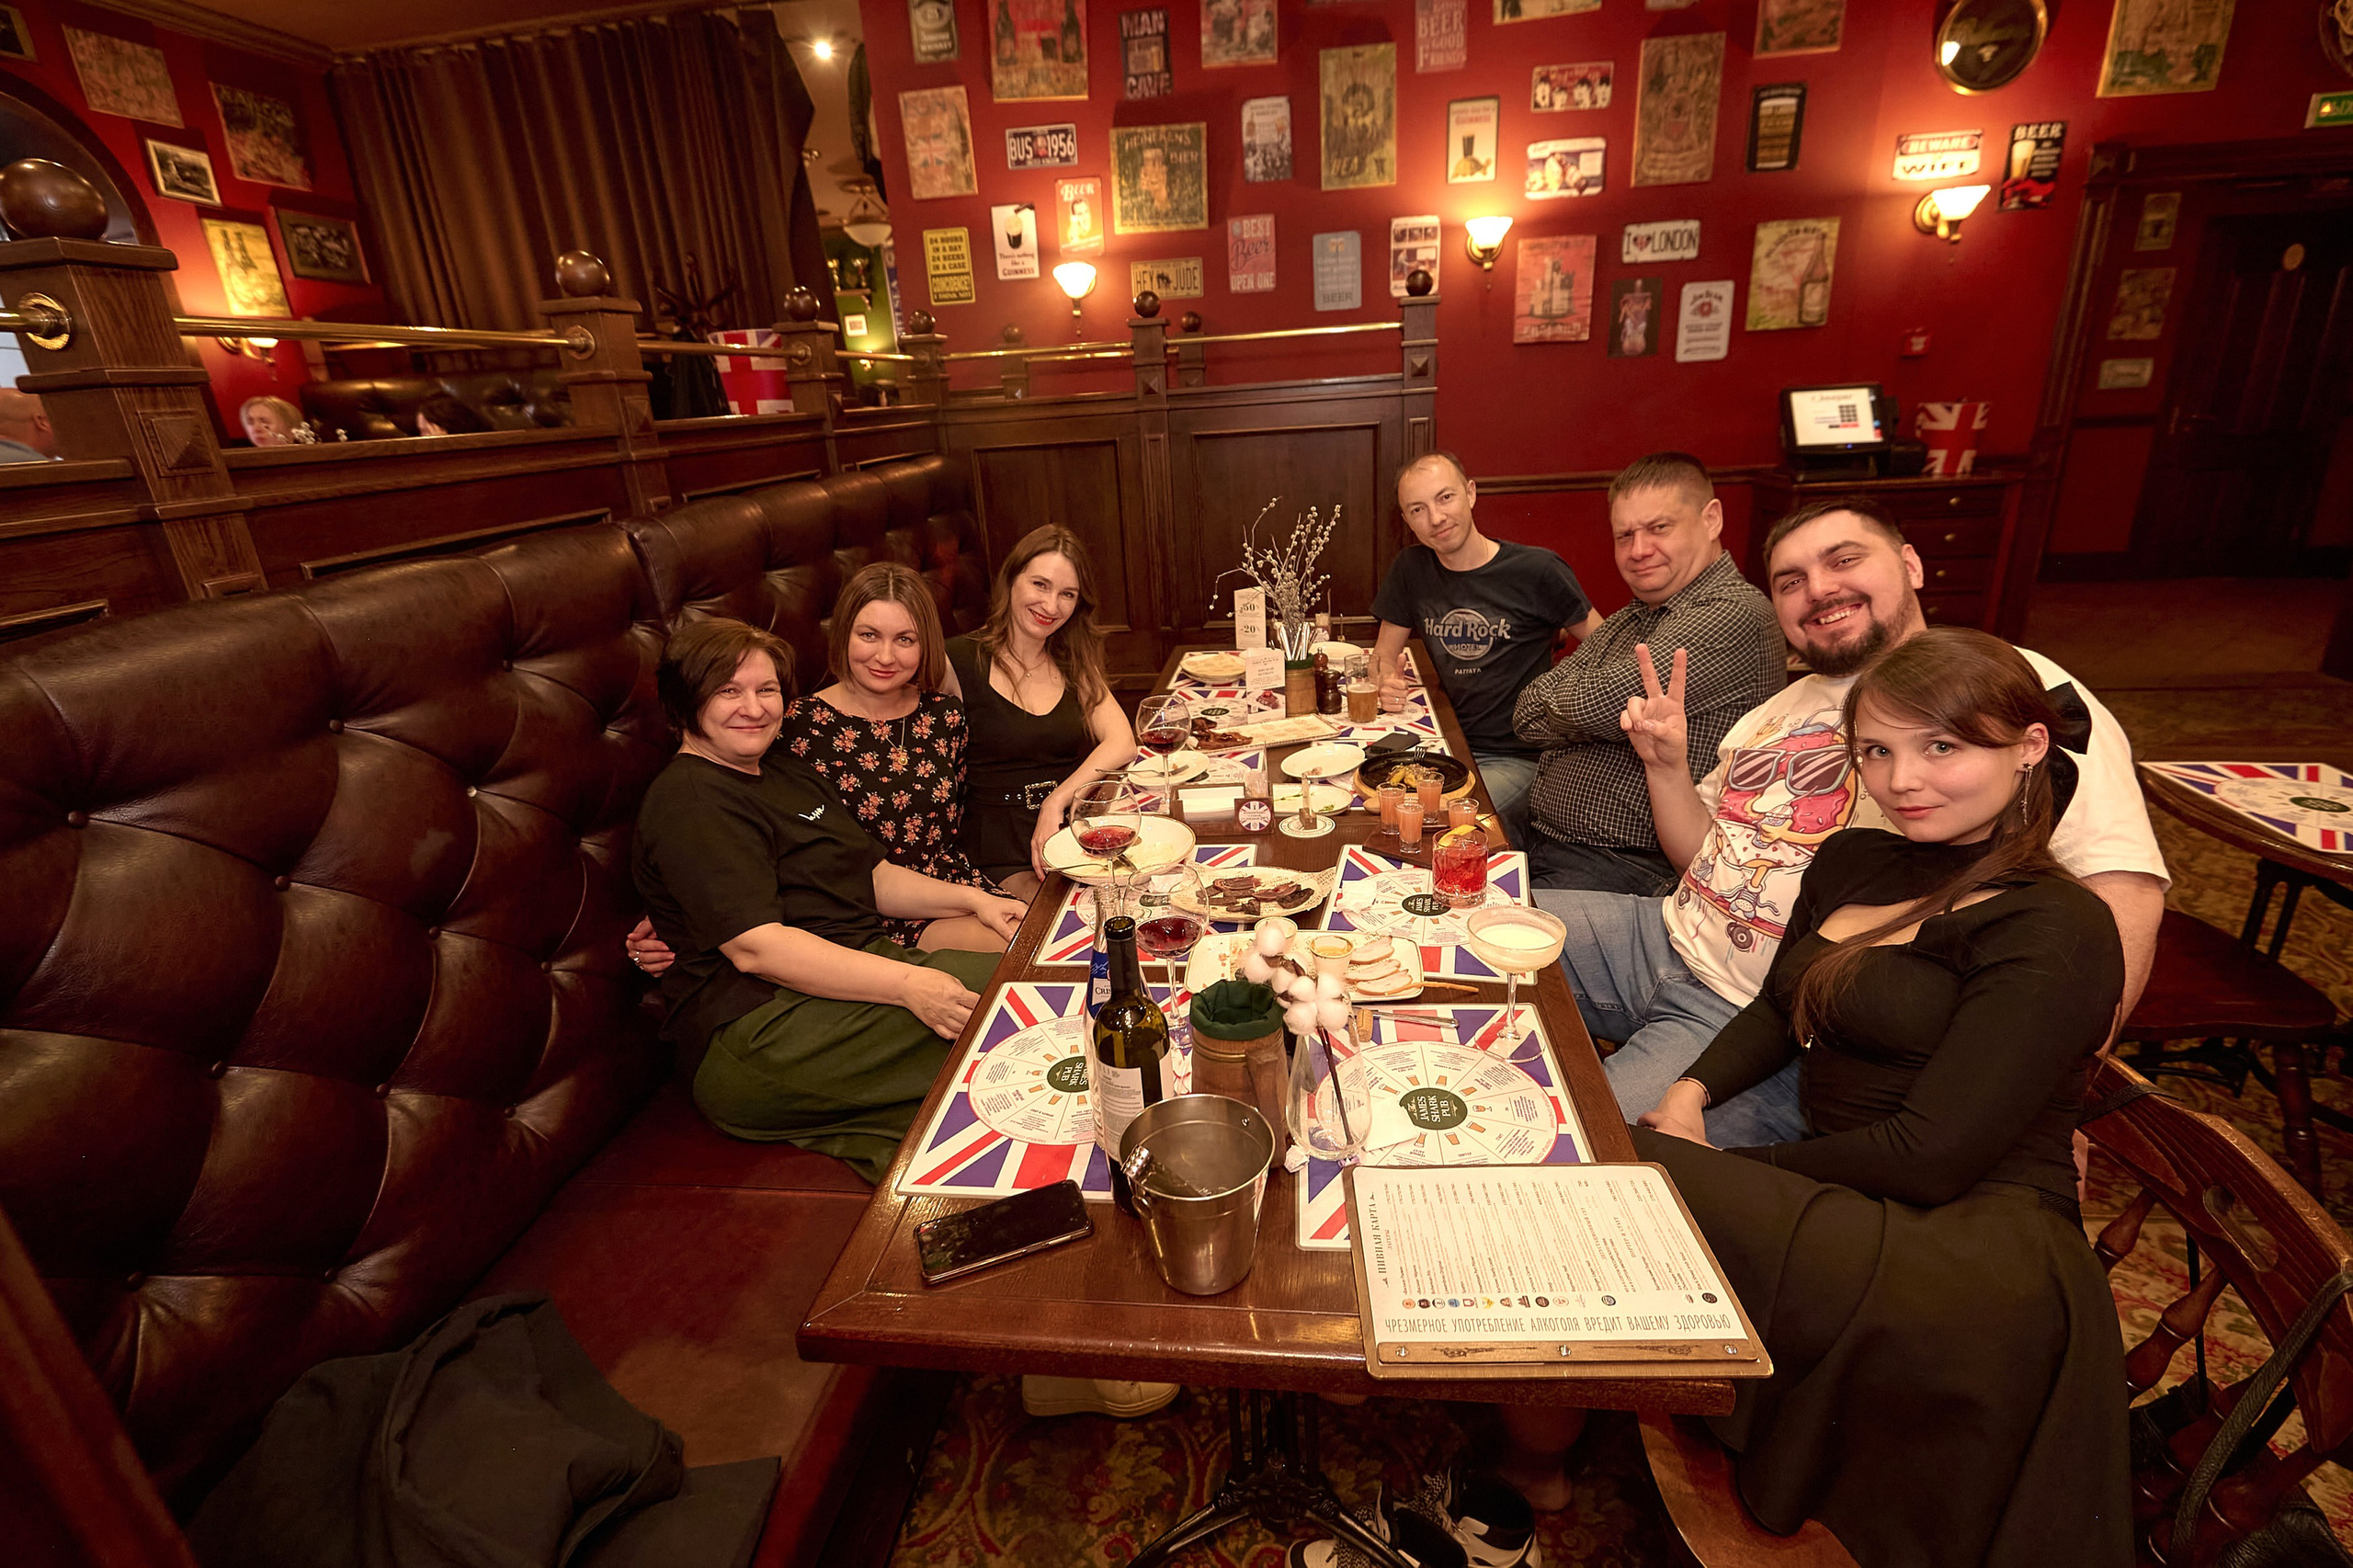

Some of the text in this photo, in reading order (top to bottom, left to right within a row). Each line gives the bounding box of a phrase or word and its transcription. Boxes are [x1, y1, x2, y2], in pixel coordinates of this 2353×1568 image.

[1121, 11, 1165, 37] MAN
[1418, 10, 1464, 37] BEER
[1126, 73, 1173, 99] CAVE
[2014, 122, 2063, 141] BEER
[1009, 132, 1074, 162] BUS 1956
[1060, 183, 1095, 201] BEER
[1243, 218, 1272, 239] BEST
[1652, 228, 1698, 253] LONDON
[1230, 237, 1272, 272] Beer
[1002, 267, 1035, 276] GUINNESS
[1174, 267, 1199, 290] JUDE
[1231, 272, 1276, 291] OPEN ONE
[1323, 292, 1353, 303] BEER
[1424, 618, 1511, 642] Hard Rock
[1453, 643, 1482, 652] HOTEL
[1061, 1067, 1073, 1081] PUB
[1069, 1062, 1084, 1086] SHARK
[1417, 1096, 1430, 1121] JAMES
[1427, 1095, 1441, 1122] SHARK
[1439, 1100, 1451, 1117] PUB
[1368, 1202, 1387, 1273] ПИВНАЯ КАРТА
[1385, 1313, 1732, 1334] ЧРЕЗМЕРНОЕ УПОТРЕБЛЕНИЕ АЛКОГОЛЯ ВРЕДИТ ВАШЕМУ ЗДОРОВЬЮ
